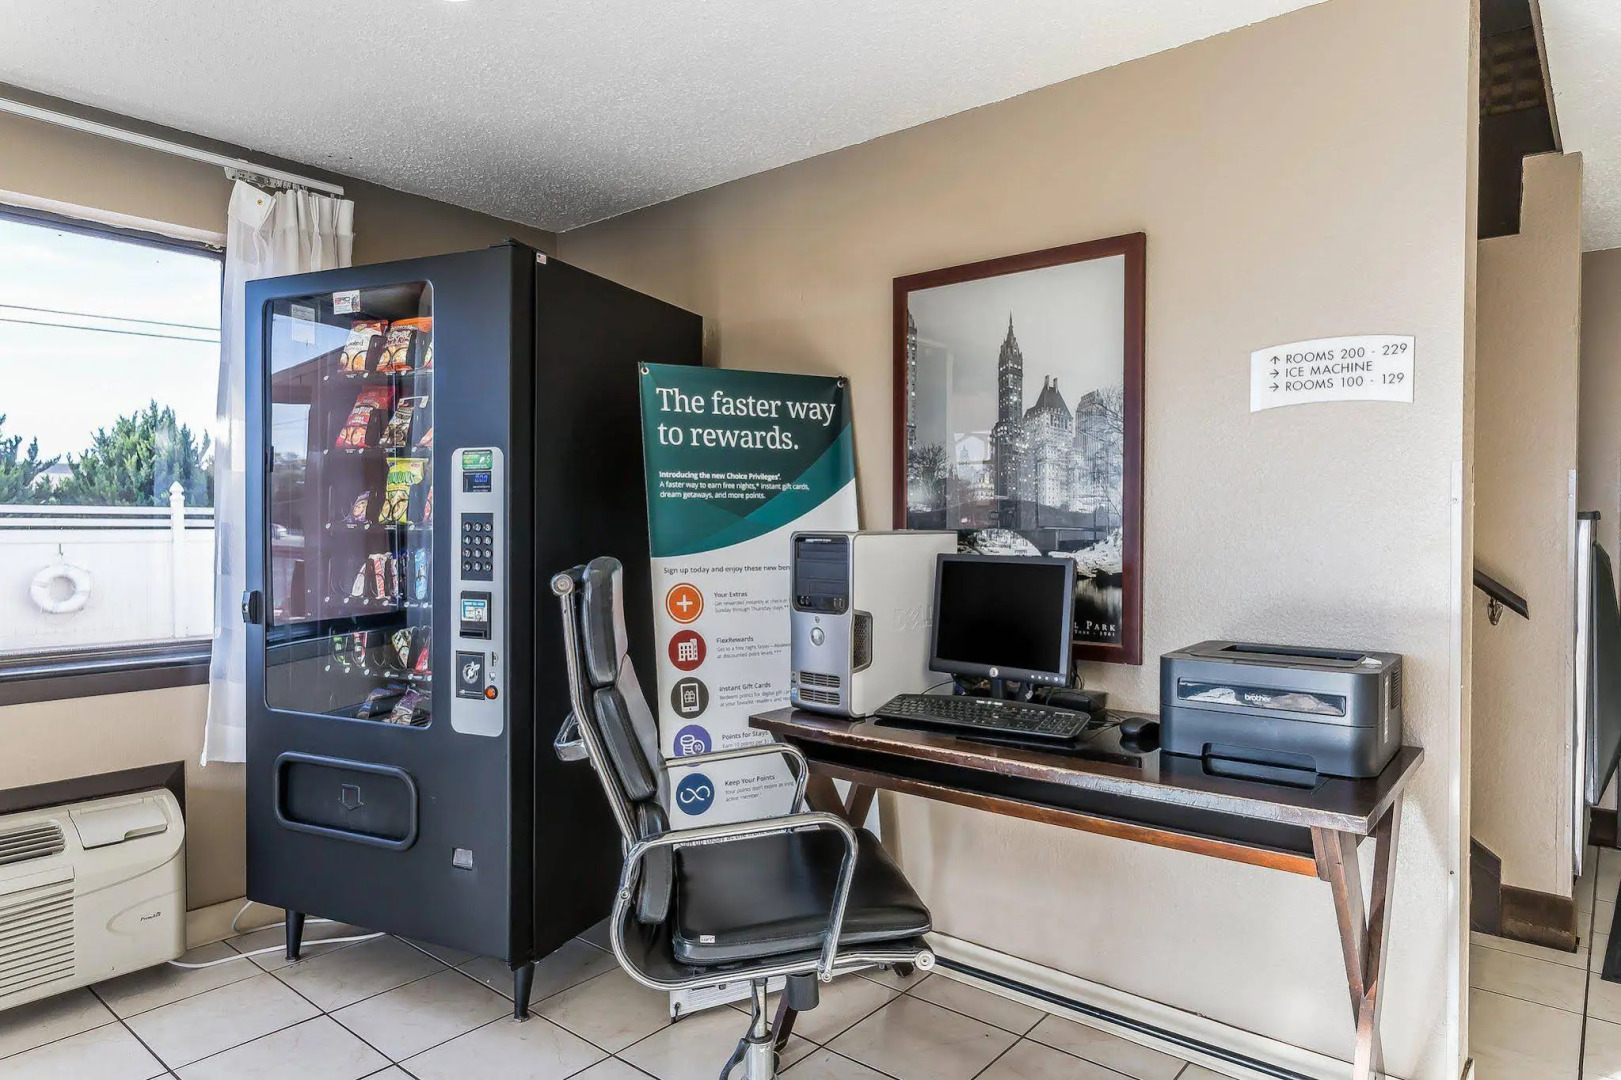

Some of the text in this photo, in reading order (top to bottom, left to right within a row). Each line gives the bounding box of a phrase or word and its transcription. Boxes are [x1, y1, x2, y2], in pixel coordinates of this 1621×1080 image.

[1285, 350, 1334, 364] ROOMS
[1341, 347, 1365, 360] 200
[1382, 343, 1408, 356] 229
[1285, 361, 1373, 378] ICE MACHINE
[1285, 378, 1334, 392] ROOMS
[1341, 376, 1364, 387] 100
[1382, 372, 1405, 384] 129
[656, 388, 836, 426] The faster way
[658, 423, 799, 450] to rewards.
[659, 471, 698, 480] Introducing
[782, 483, 792, 491] gift
[664, 567, 678, 575] Sign
